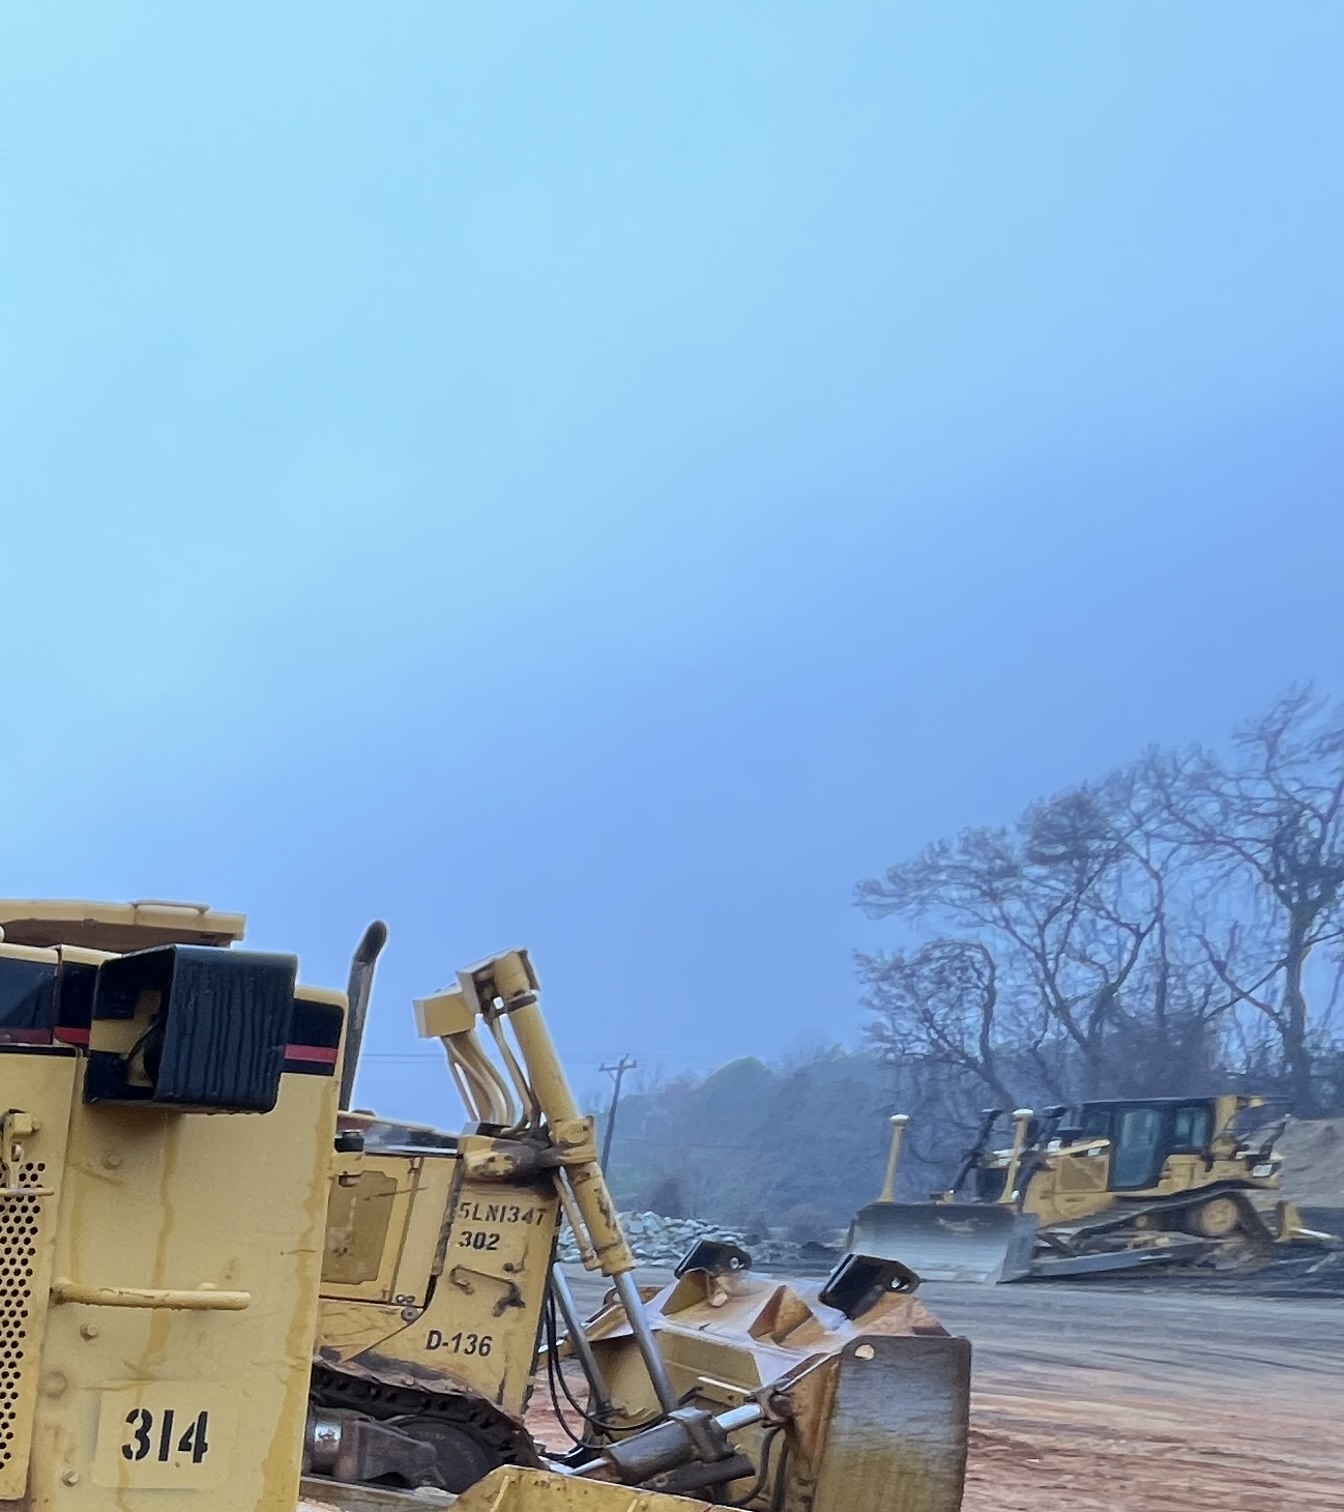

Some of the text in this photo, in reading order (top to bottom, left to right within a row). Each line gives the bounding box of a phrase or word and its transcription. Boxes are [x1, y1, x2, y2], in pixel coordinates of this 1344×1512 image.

[457, 1230, 501, 1250] 302
[425, 1329, 493, 1357] D-136
[121, 1408, 209, 1464] 314
